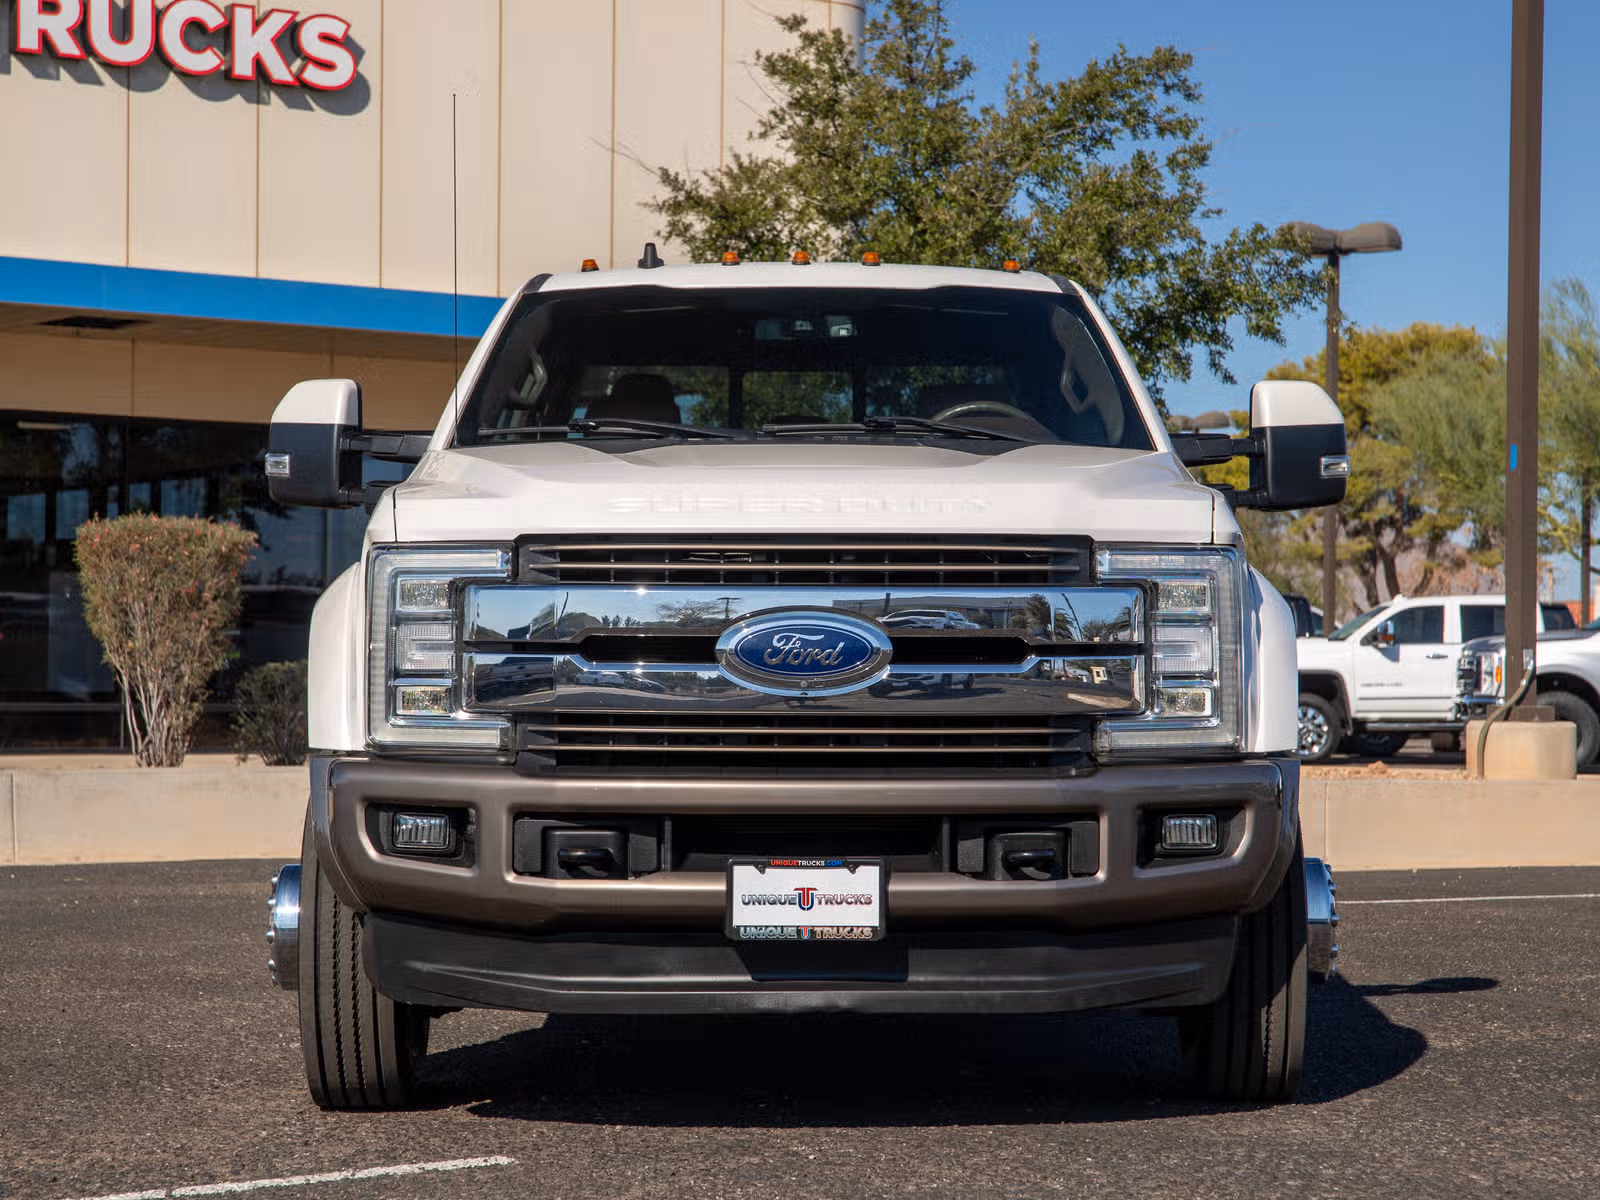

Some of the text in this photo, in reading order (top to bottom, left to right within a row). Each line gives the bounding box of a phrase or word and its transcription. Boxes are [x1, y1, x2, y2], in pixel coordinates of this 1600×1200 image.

[763, 632, 845, 665] Ford
[741, 894, 797, 906] UNIQUE
[815, 893, 873, 906] TRUCKS
[739, 926, 797, 939] UNIQUE
[813, 926, 873, 939] TRUCKS
